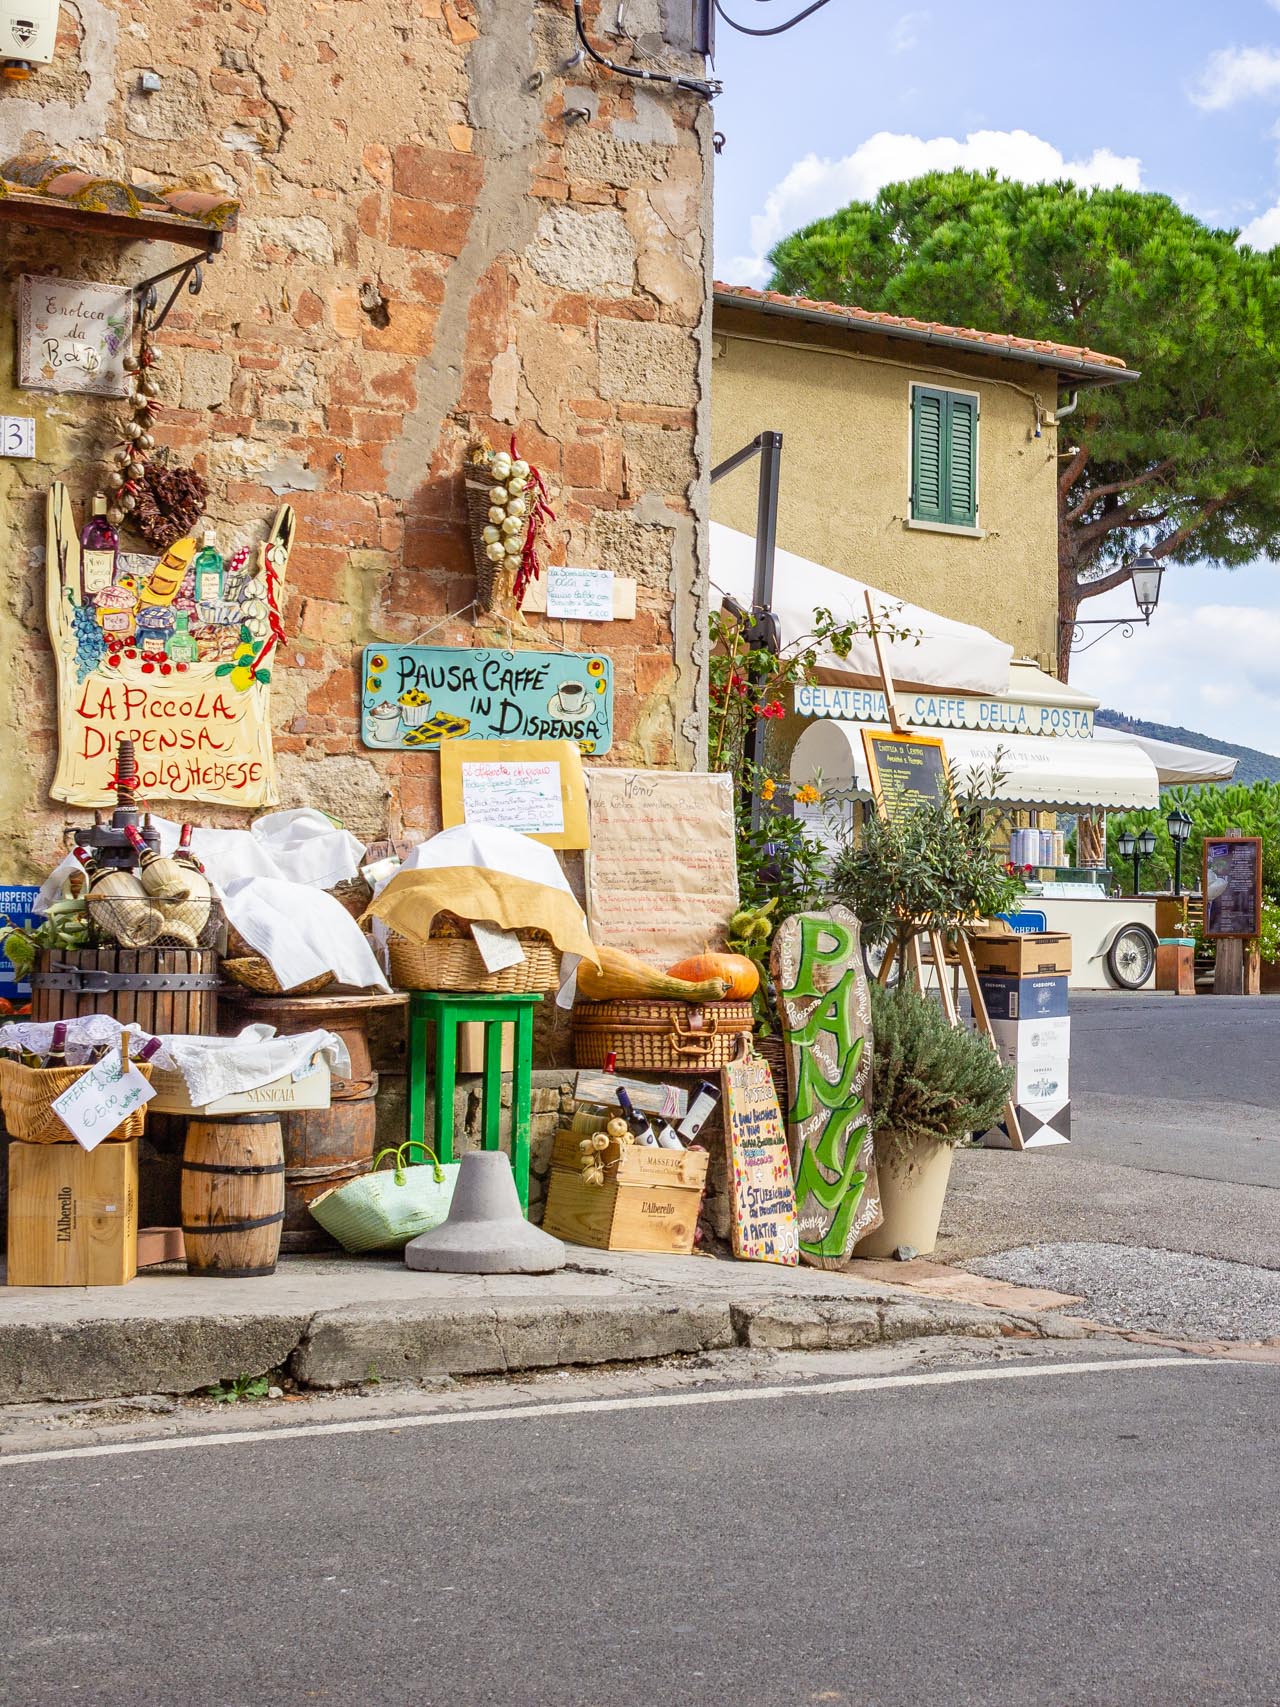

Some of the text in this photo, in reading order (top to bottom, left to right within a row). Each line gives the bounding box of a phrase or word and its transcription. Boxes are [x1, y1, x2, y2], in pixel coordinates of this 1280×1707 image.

[11, 26, 38, 36] FAAC
[45, 295, 105, 320] Enoteca
[64, 323, 86, 340] da
[8, 423, 24, 450] 3
[396, 655, 477, 694] PAUSA
[74, 679, 117, 721] LA
[800, 687, 887, 713] GELATERIA
[980, 703, 1026, 725] DELLA
[1040, 708, 1089, 730] POSTA
[470, 696, 602, 741] IN DISPENSA
[76, 725, 226, 760] DISPENSA
[0, 902, 22, 913] ERRA
[55, 1069, 98, 1115] OFFERTA
[247, 1087, 295, 1103] SASSICAIA
[641, 1201, 675, 1215] L'Alberello
[740, 1185, 747, 1209] 1
[57, 1186, 73, 1242] L'Alberello
[743, 1224, 749, 1242] A
[750, 1221, 778, 1241] PARTIRE
[765, 1240, 775, 1255] DA
